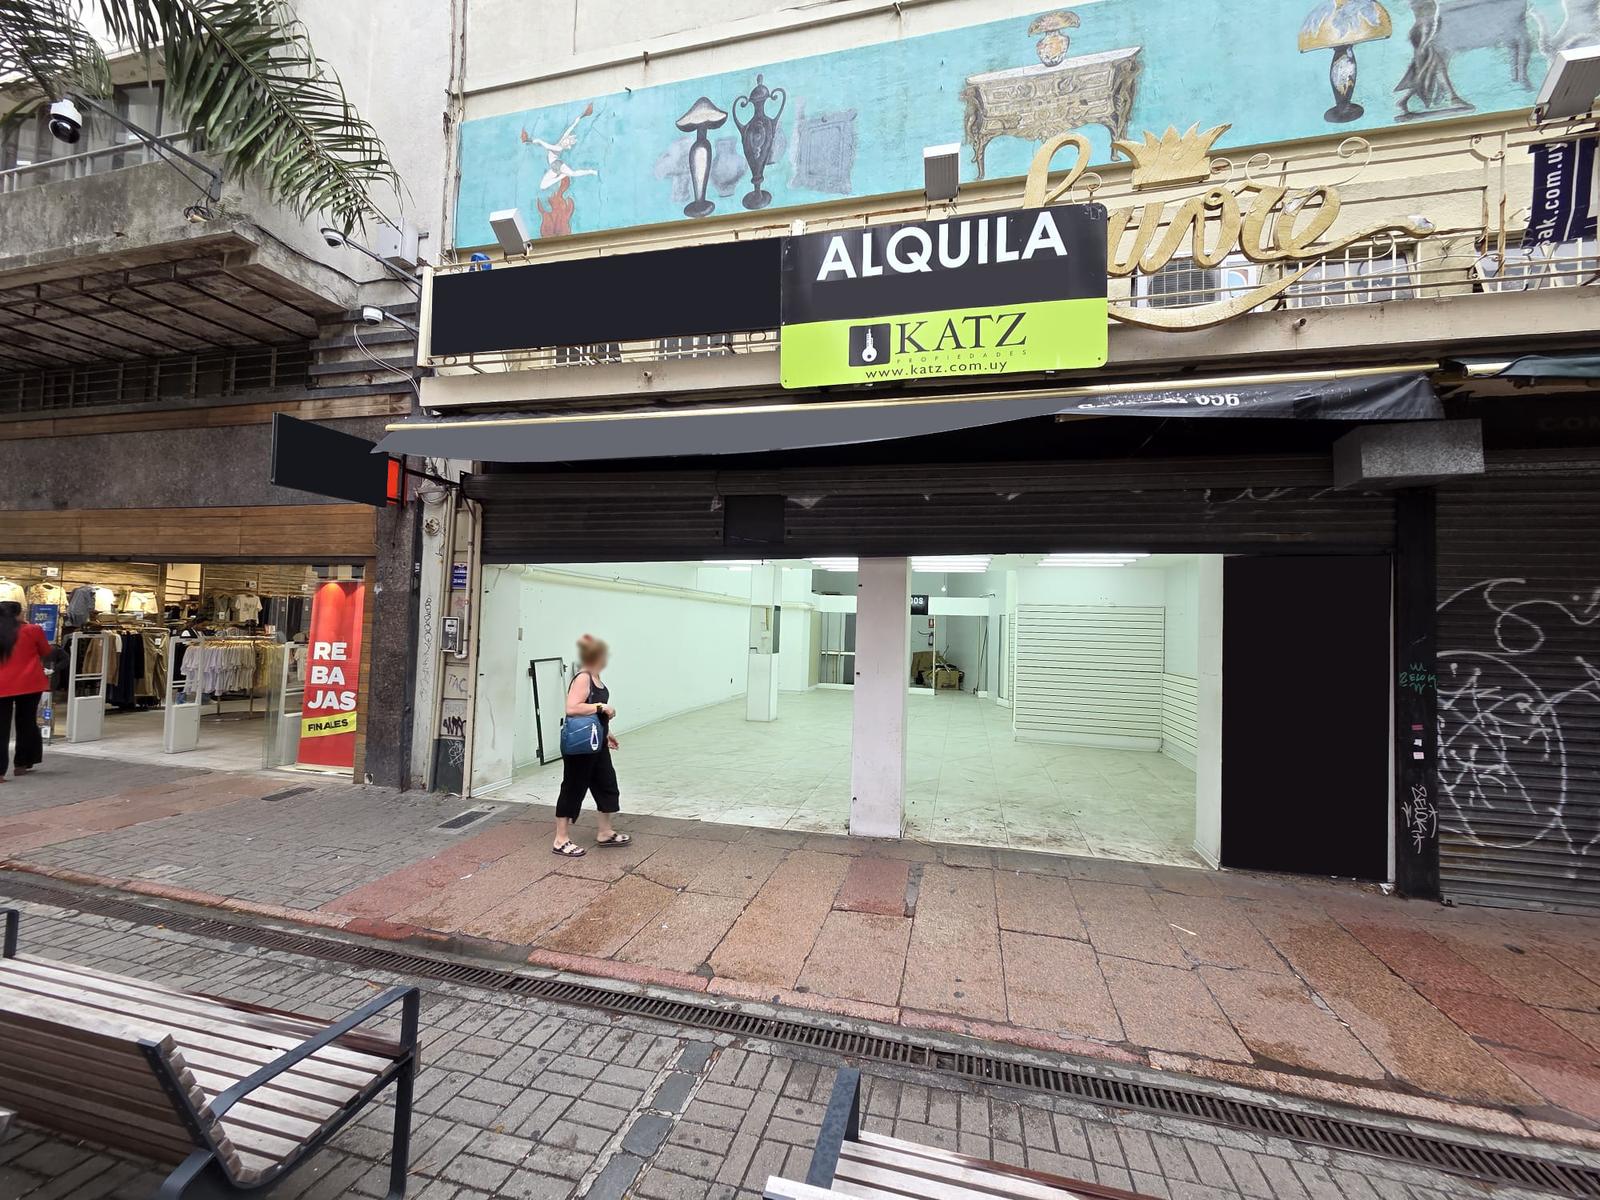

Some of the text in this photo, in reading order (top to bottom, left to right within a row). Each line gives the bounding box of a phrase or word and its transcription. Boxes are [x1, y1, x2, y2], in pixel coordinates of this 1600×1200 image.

[816, 211, 1067, 281] ALQUILA
[895, 312, 1027, 355] KATZ
[896, 350, 1027, 364] PROPIEDADES
[865, 361, 1008, 379] www.katz.com.uy
[313, 641, 347, 661] RE
[310, 666, 345, 685] BA
[307, 690, 356, 711] JAS
[308, 718, 349, 731] FINALES
